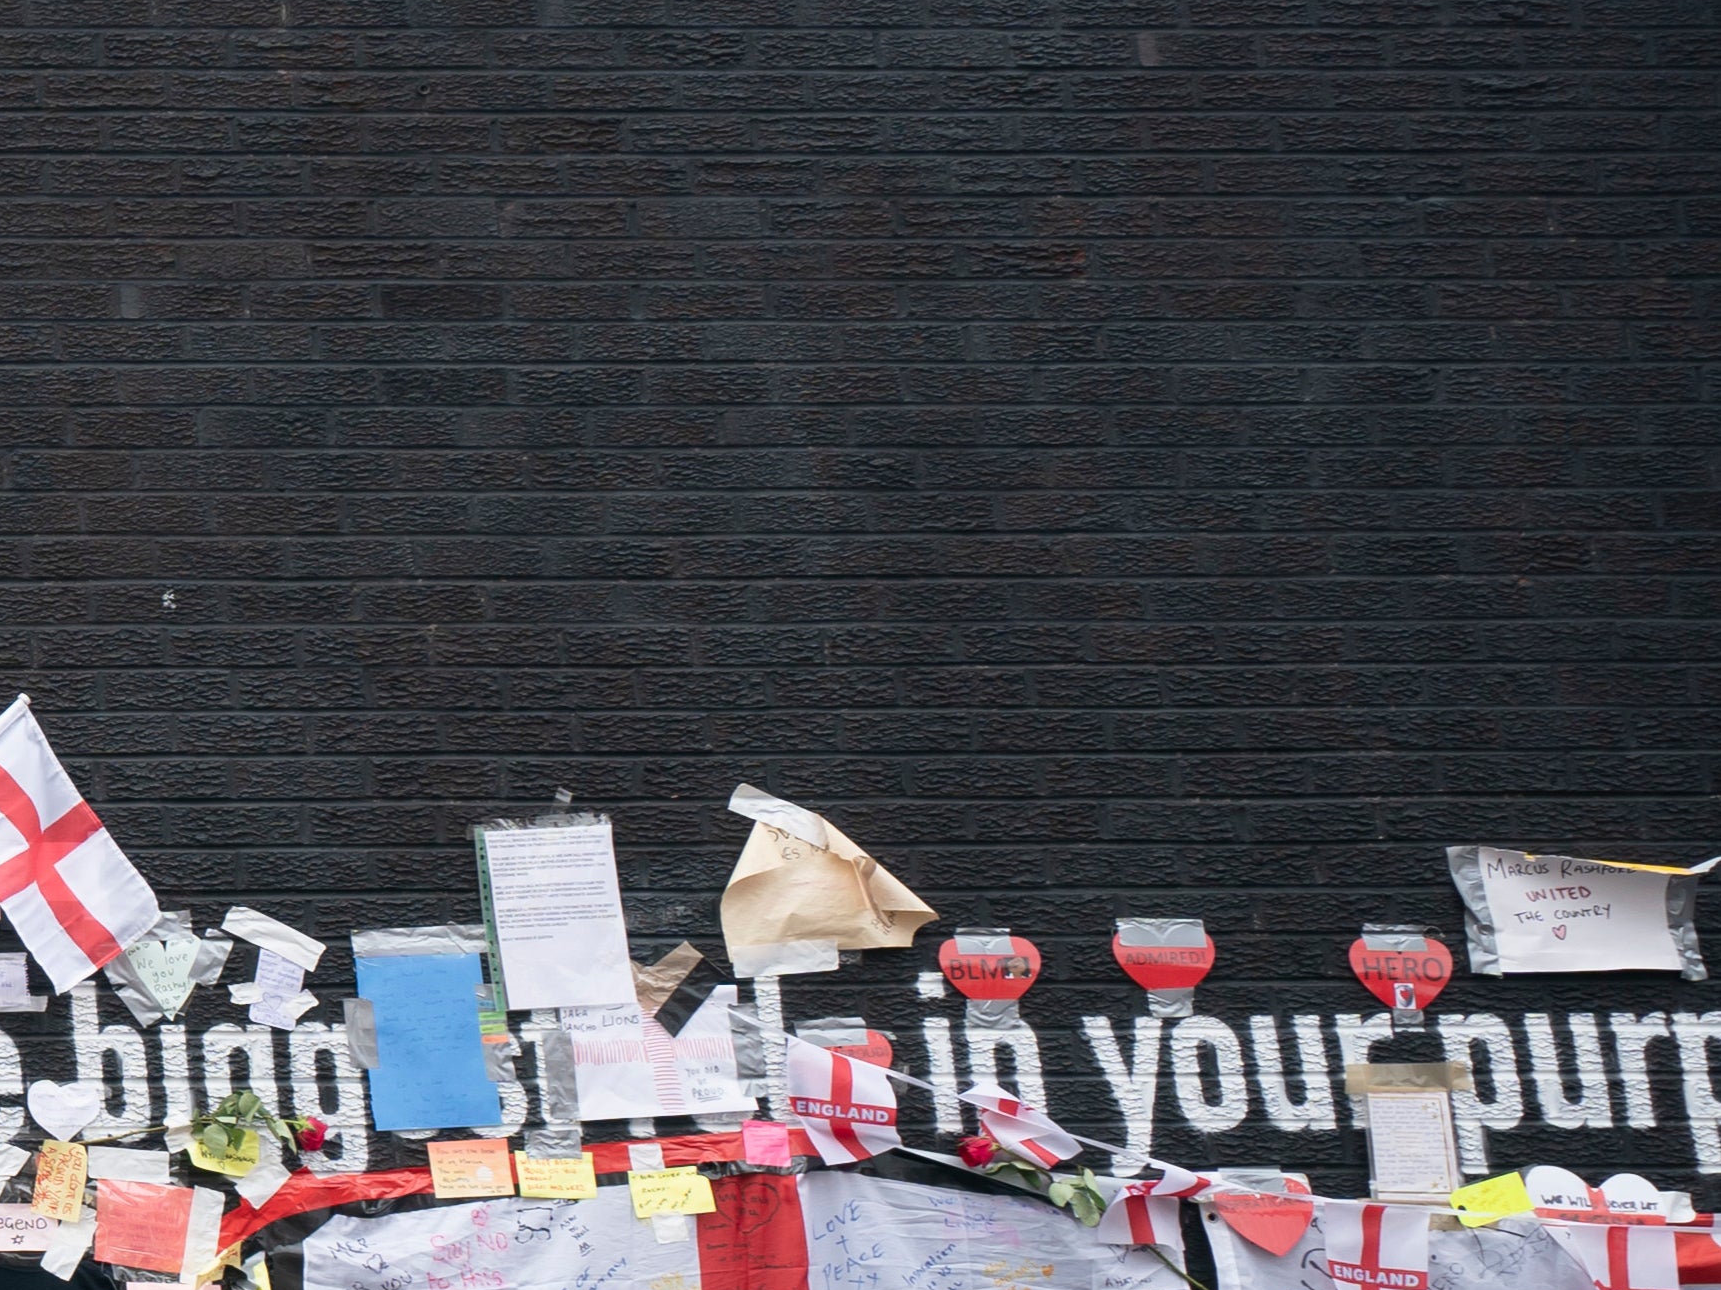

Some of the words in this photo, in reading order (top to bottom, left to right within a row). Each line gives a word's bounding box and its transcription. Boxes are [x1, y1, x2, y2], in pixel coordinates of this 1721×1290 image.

[1525, 886, 1592, 902] UNITED
[1514, 911, 1544, 924] THE
[1553, 904, 1611, 921] COUNTRY
[136, 958, 155, 970] We
[164, 952, 189, 966] love
[1125, 951, 1206, 966] ADMIRED!
[1361, 957, 1445, 982] HERO
[152, 968, 175, 981] you
[917, 972, 1046, 1134] in
[1083, 1010, 1392, 1177] your
[796, 1099, 890, 1125] ENGLAND
[811, 1200, 861, 1242] LOVE
[821, 1243, 886, 1284] PEACE
[1333, 1264, 1420, 1290] ENGLAND
